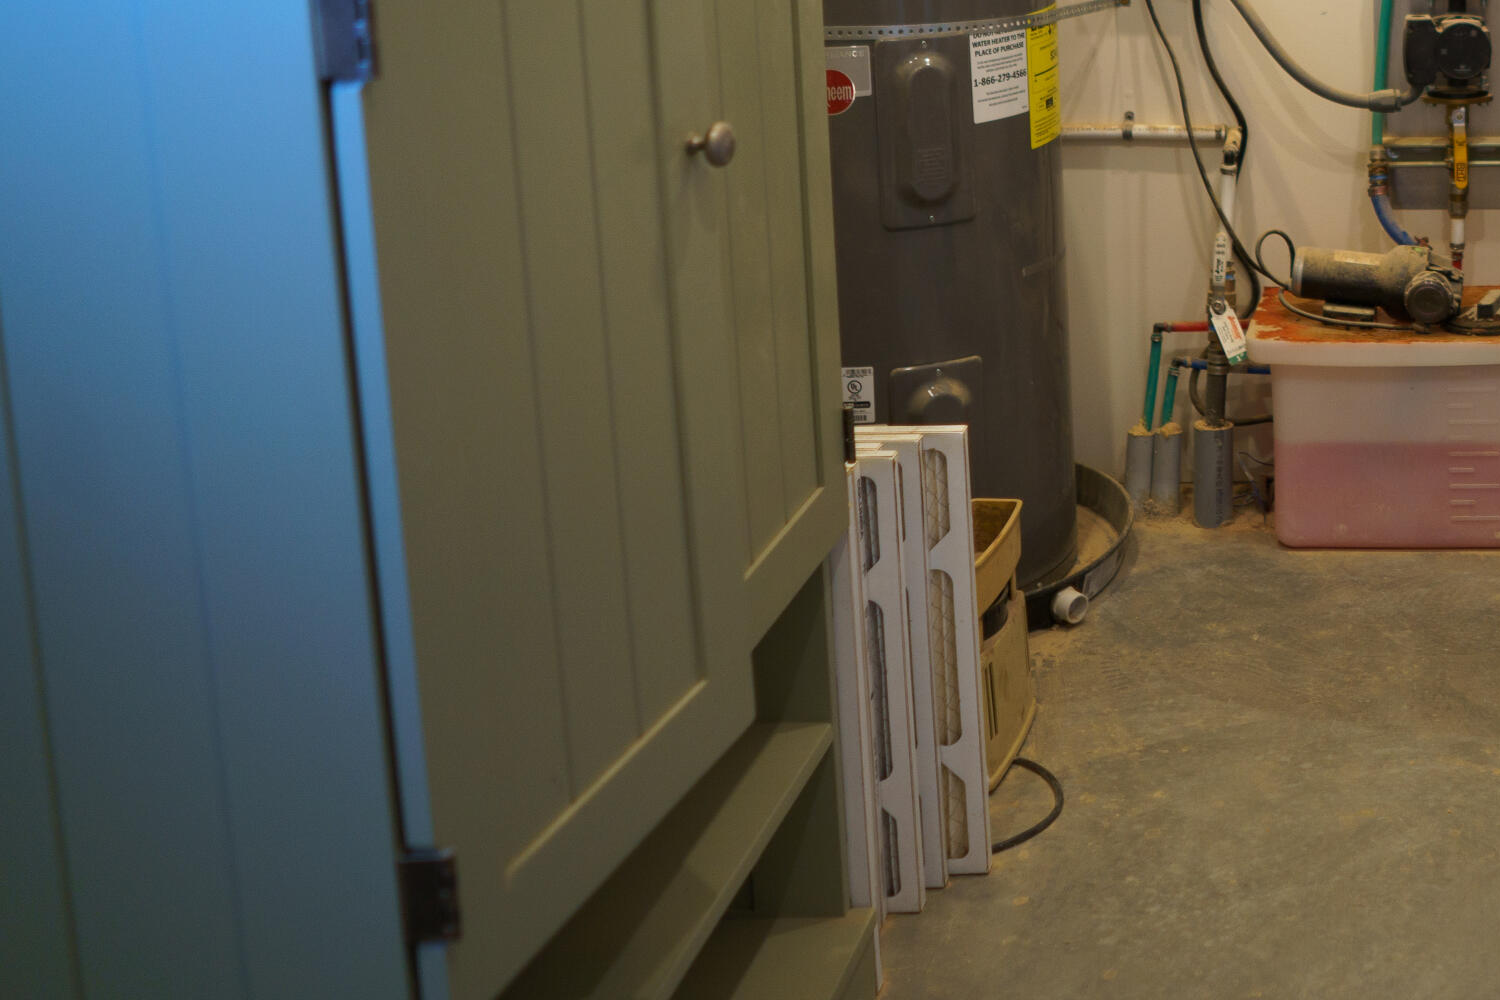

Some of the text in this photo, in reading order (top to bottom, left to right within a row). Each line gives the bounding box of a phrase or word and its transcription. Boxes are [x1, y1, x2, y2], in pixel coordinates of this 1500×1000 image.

[972, 40, 991, 48] WATER
[991, 36, 1011, 45] HEATER
[1016, 32, 1025, 40] THE
[974, 49, 992, 57] PLACE
[1000, 41, 1024, 53] PURCHASE
[973, 68, 1027, 88] 1-866-279-4566
